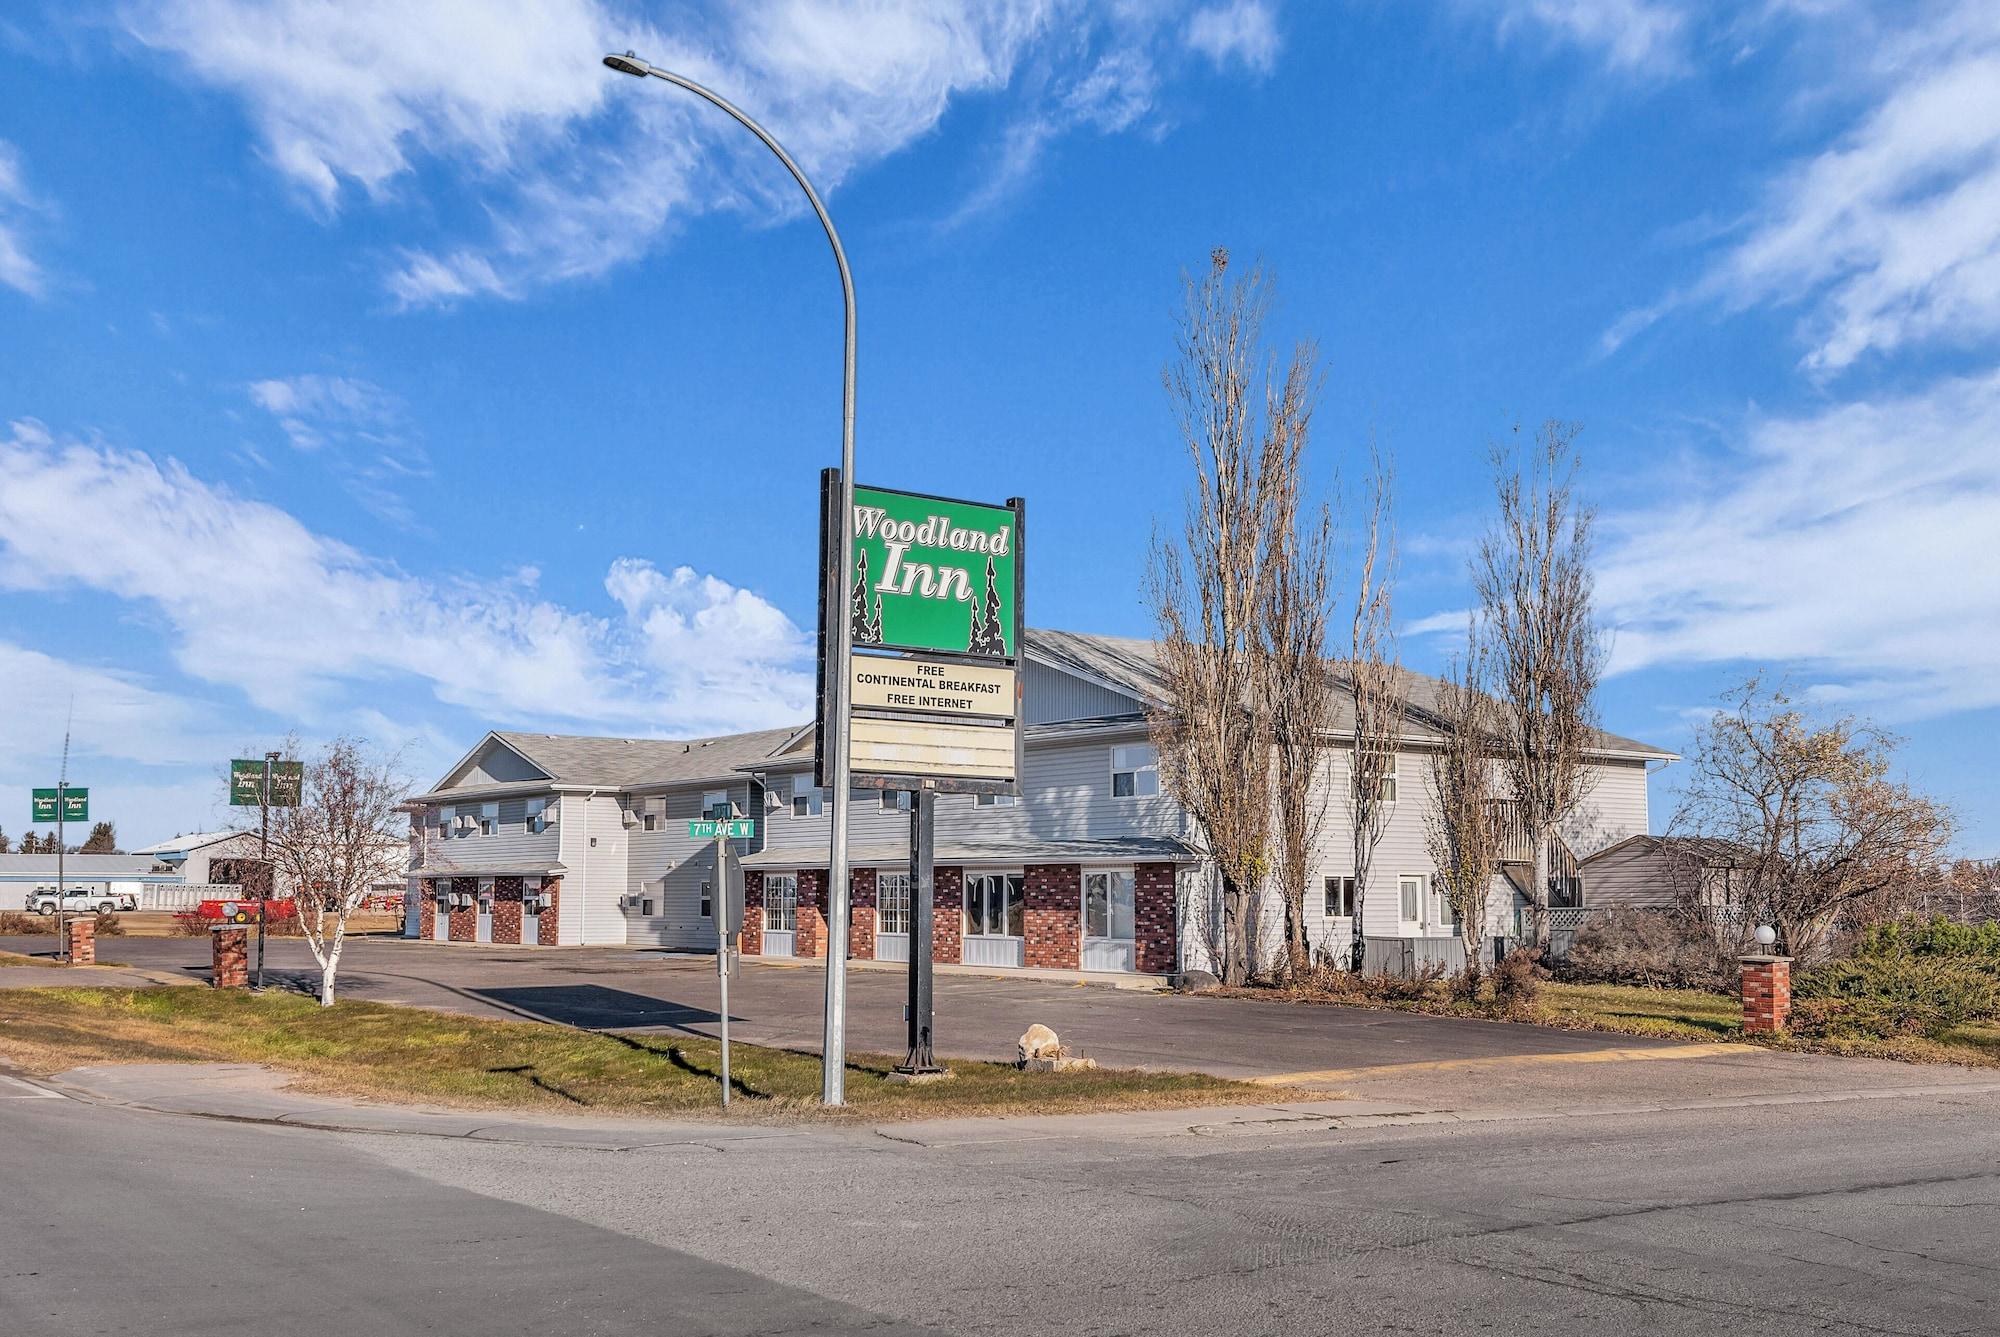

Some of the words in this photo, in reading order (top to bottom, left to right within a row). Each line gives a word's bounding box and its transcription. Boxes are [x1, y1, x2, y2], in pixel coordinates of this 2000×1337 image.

[853, 505, 1011, 556] Woodland
[874, 541, 974, 602] Inn
[917, 665, 945, 677] FREE
[856, 673, 936, 689] CONTINENTAL
[938, 681, 1001, 695] BREAKFAST
[887, 693, 916, 705] FREE
[918, 696, 973, 710] INTERNET
[237, 778, 255, 789] Inn
[68, 801, 82, 809] Inn
[693, 823, 712, 836] 7TH
[714, 823, 735, 836] AVE
[739, 823, 749, 836] W
